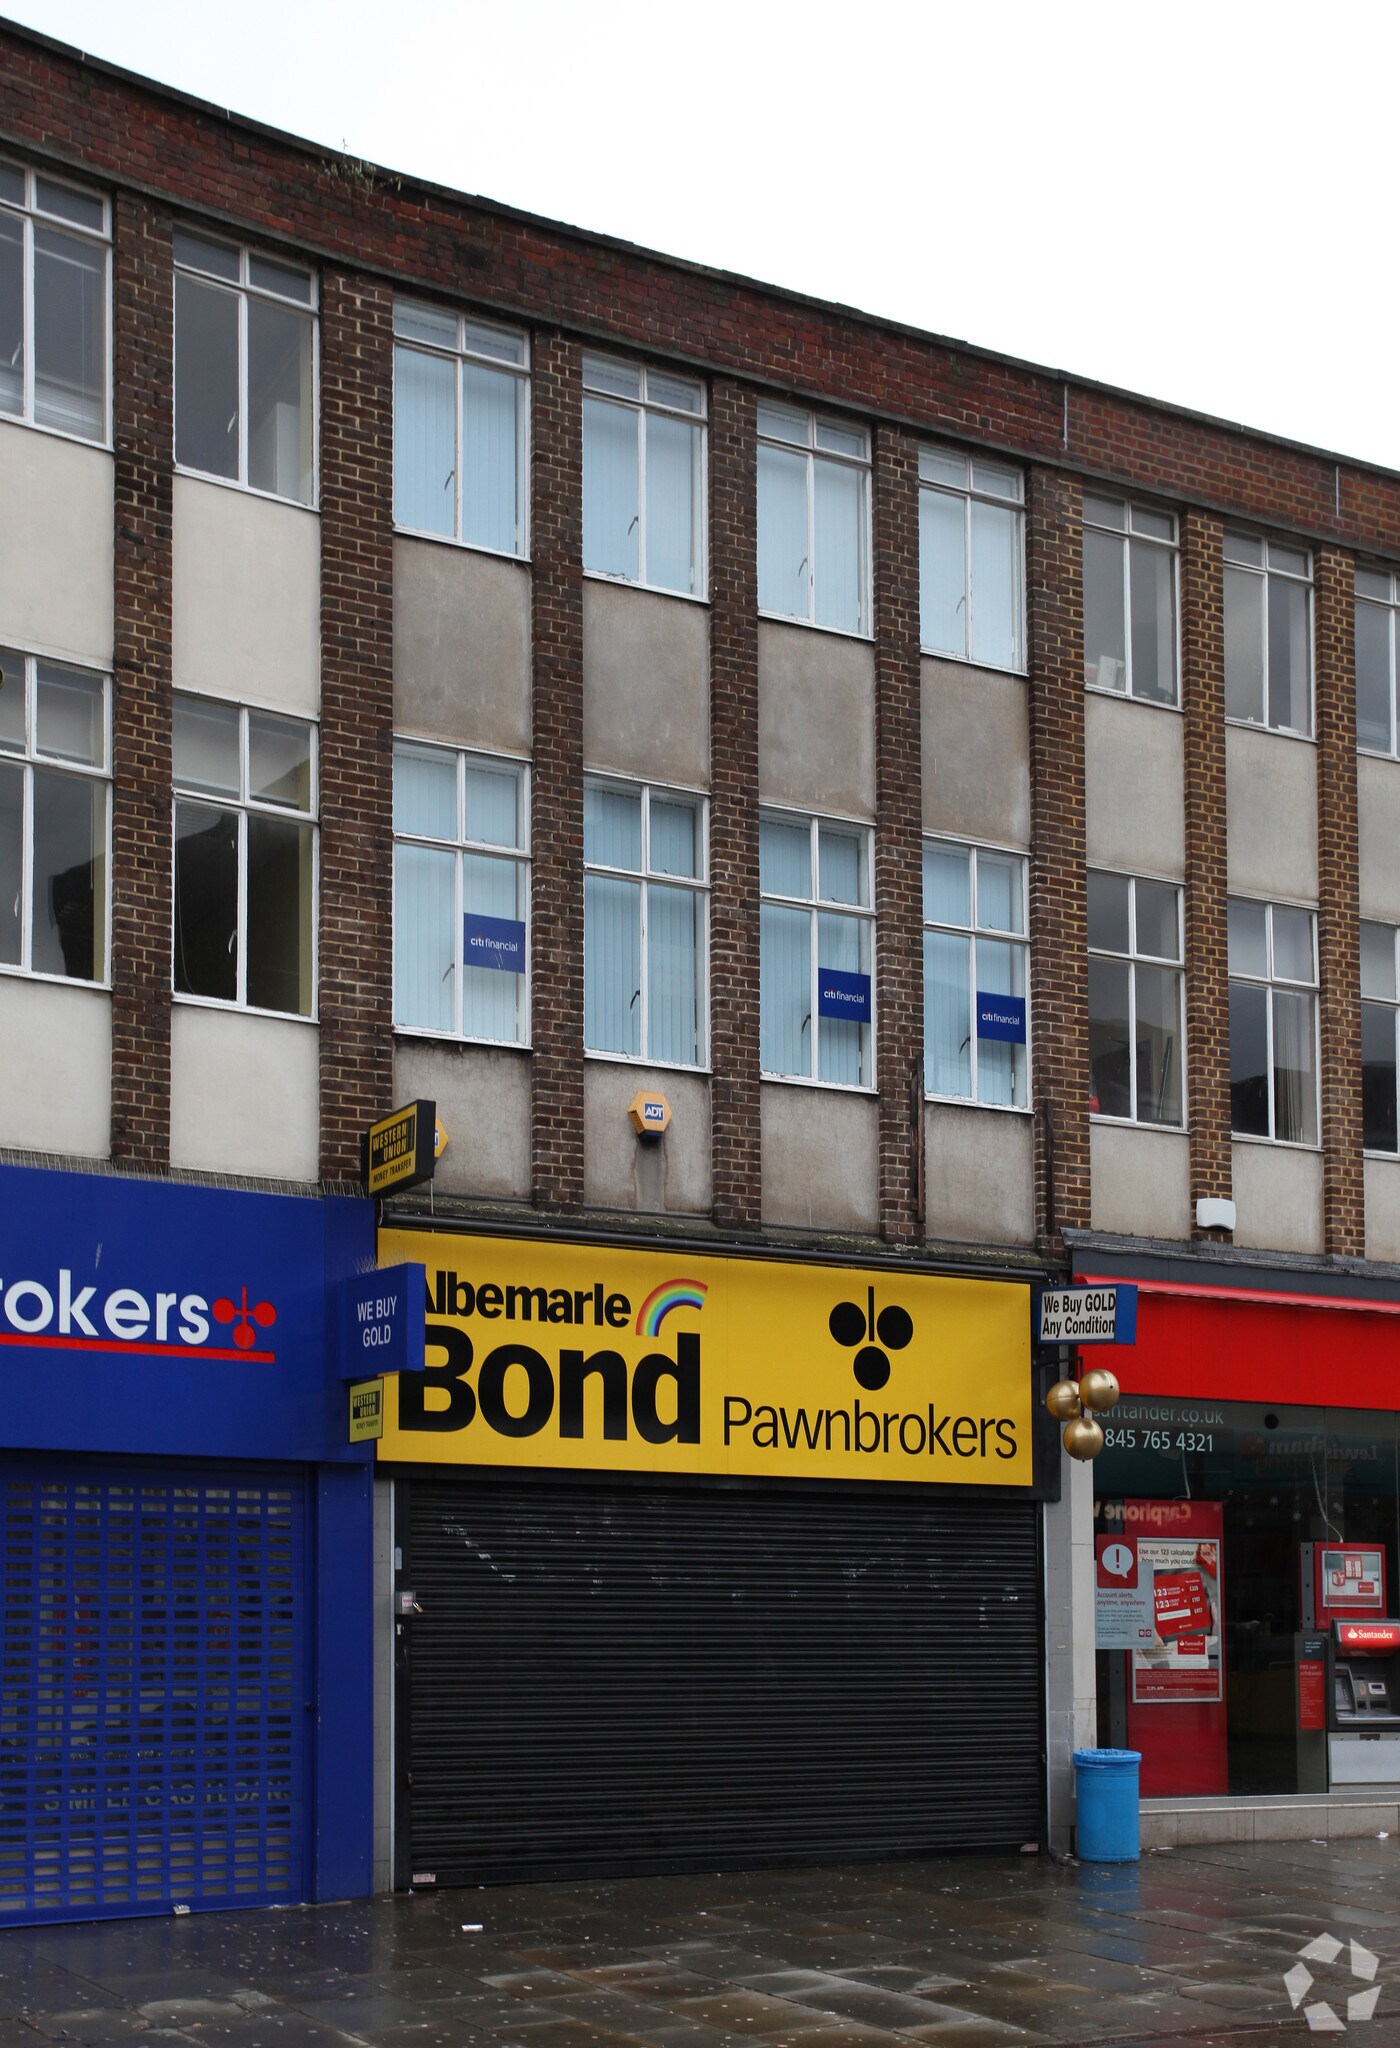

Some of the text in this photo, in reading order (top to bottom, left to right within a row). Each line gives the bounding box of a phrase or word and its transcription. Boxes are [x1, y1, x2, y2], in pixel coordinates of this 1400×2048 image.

[485, 937, 518, 952] financial
[836, 990, 865, 1004] financial
[993, 1013, 1020, 1025] financial
[645, 1106, 664, 1118] ADT
[372, 1121, 407, 1152] WESTERN
[383, 1137, 407, 1162] UNION
[373, 1158, 412, 1184] MONEY TRANSFER
[0, 1268, 210, 1345] okers
[357, 1295, 398, 1322] WE BUY
[1044, 1292, 1116, 1316] We Buy GOLD
[1042, 1315, 1115, 1338] Any Condition
[362, 1324, 392, 1348] GOLD
[398, 1324, 700, 1444] Bond
[353, 1393, 376, 1408] WESTERN
[360, 1404, 376, 1418] UNION
[723, 1395, 1018, 1459] Pawnbrokers
[1141, 1430, 1171, 1450] 765
[1175, 1432, 1213, 1453] 4321
[1161, 1548, 1170, 1556] 123
[1170, 1558, 1181, 1566] you
[1118, 1591, 1134, 1599] alerts,
[1154, 1588, 1168, 1597] 123
[1097, 1599, 1119, 1607] anytime,
[1155, 1599, 1170, 1609] 123
[1358, 1629, 1393, 1639] Santander
